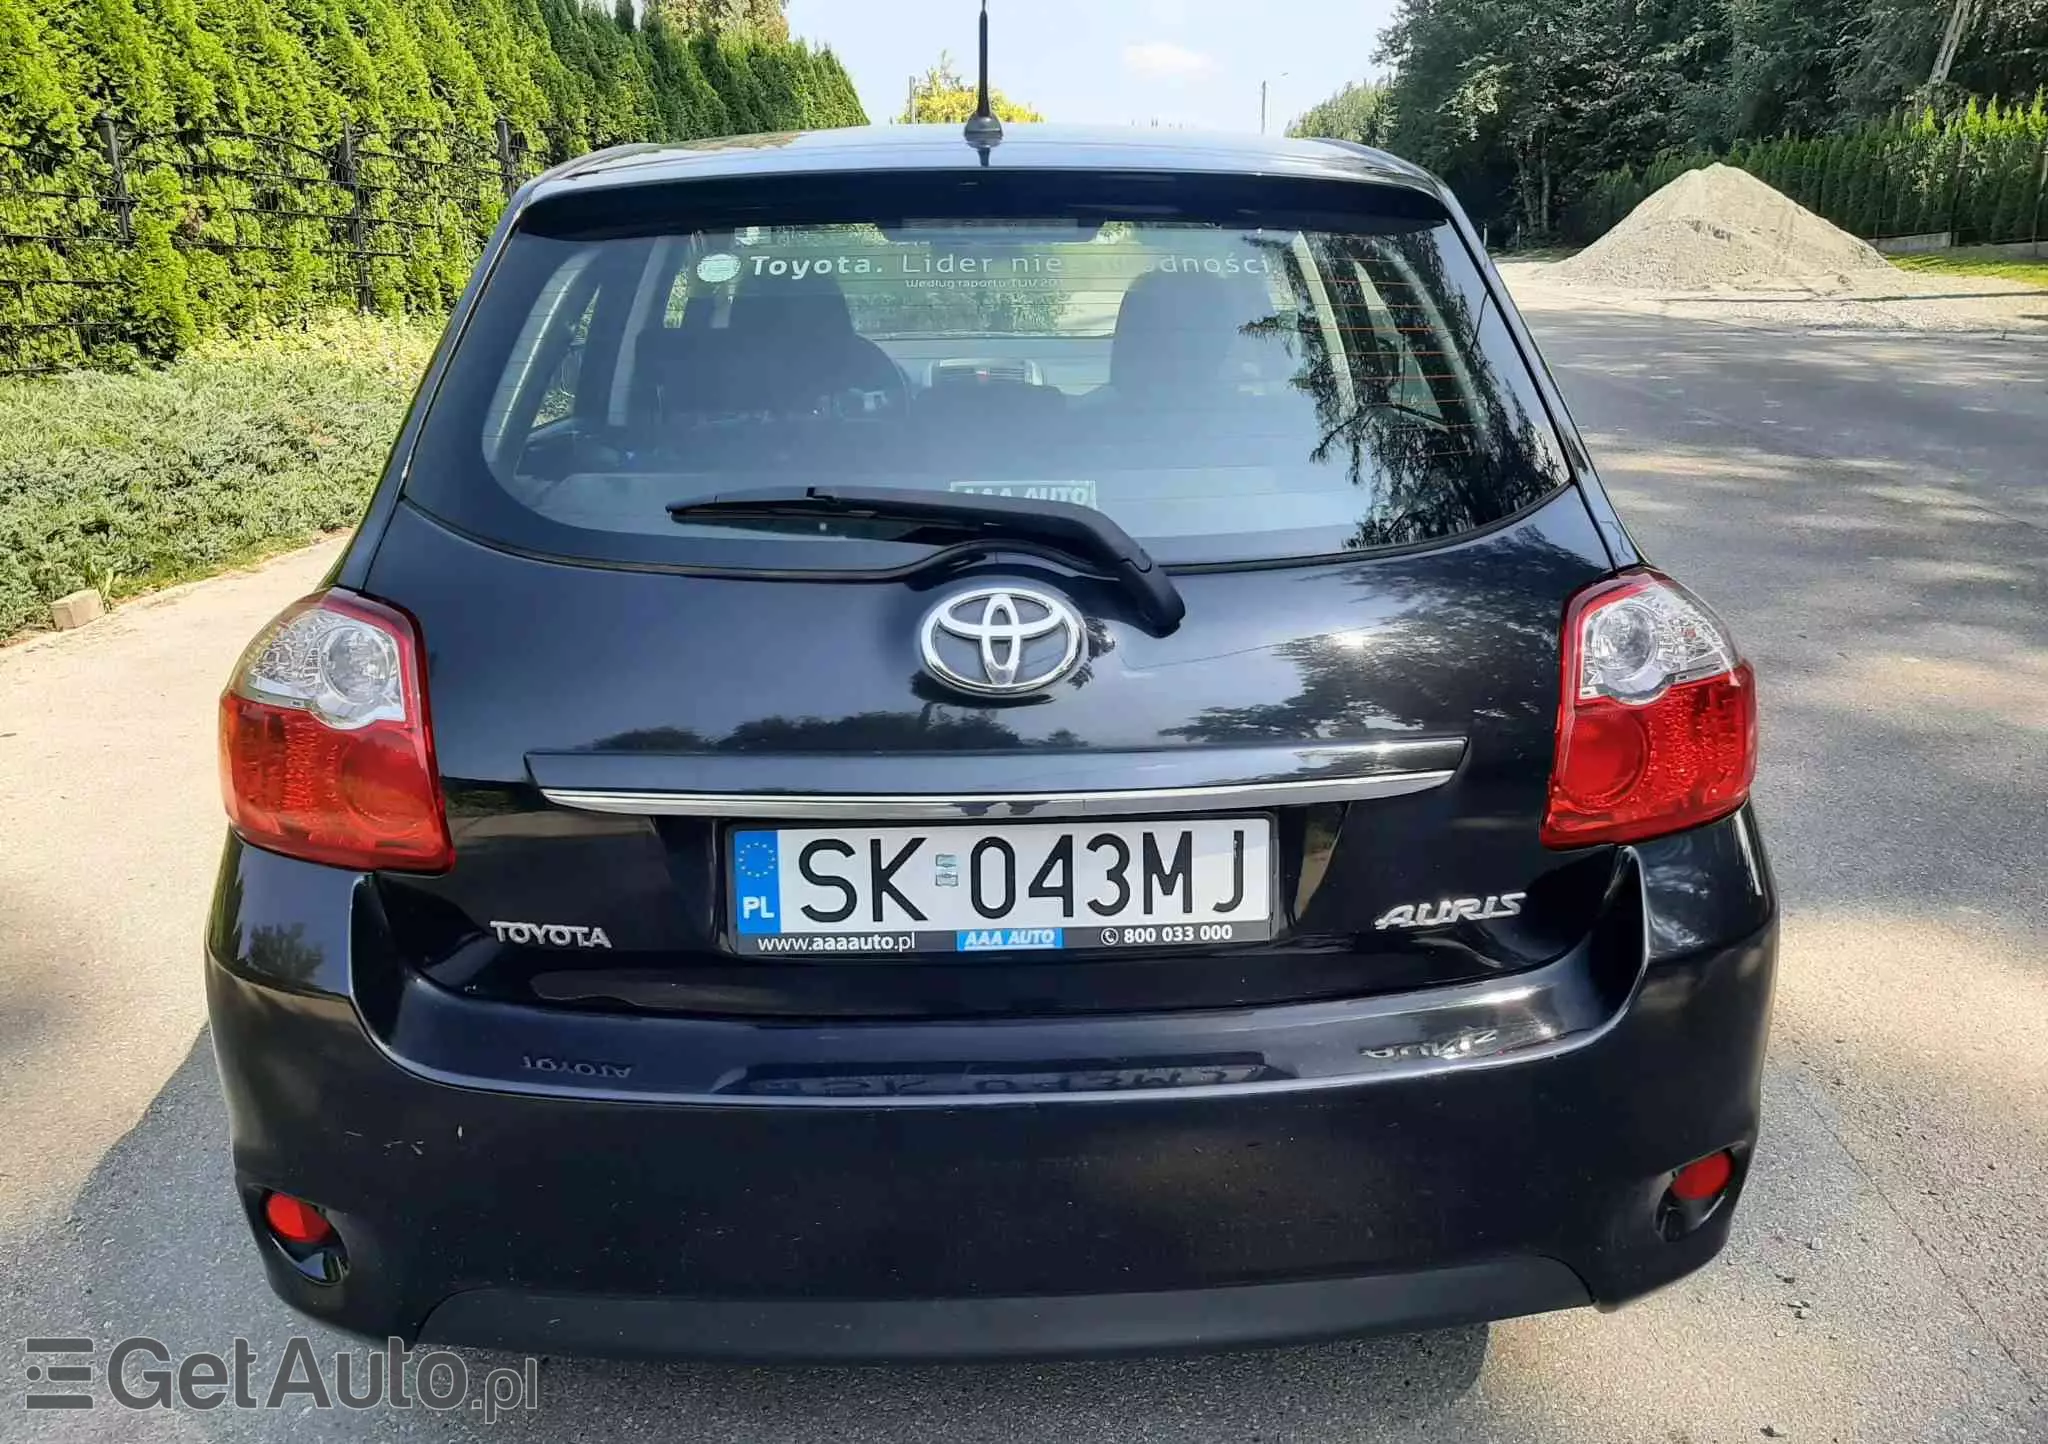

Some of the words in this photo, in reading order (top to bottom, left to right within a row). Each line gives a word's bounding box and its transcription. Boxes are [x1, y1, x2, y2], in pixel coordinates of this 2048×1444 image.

[750, 254, 882, 280] Toyota.
[902, 253, 993, 273] Lider
[798, 836, 929, 922] SK
[969, 829, 1245, 920] 043MJ
[742, 896, 775, 919] PL
[1374, 891, 1527, 930] AURIS
[489, 920, 613, 949] TOYOTA
[757, 931, 916, 952] www.aaaauto.pl
[964, 930, 1001, 946] AAA
[1008, 928, 1056, 945] AUTO
[1123, 927, 1156, 944] 800
[1161, 926, 1195, 943] 033
[1200, 924, 1233, 941] 000
